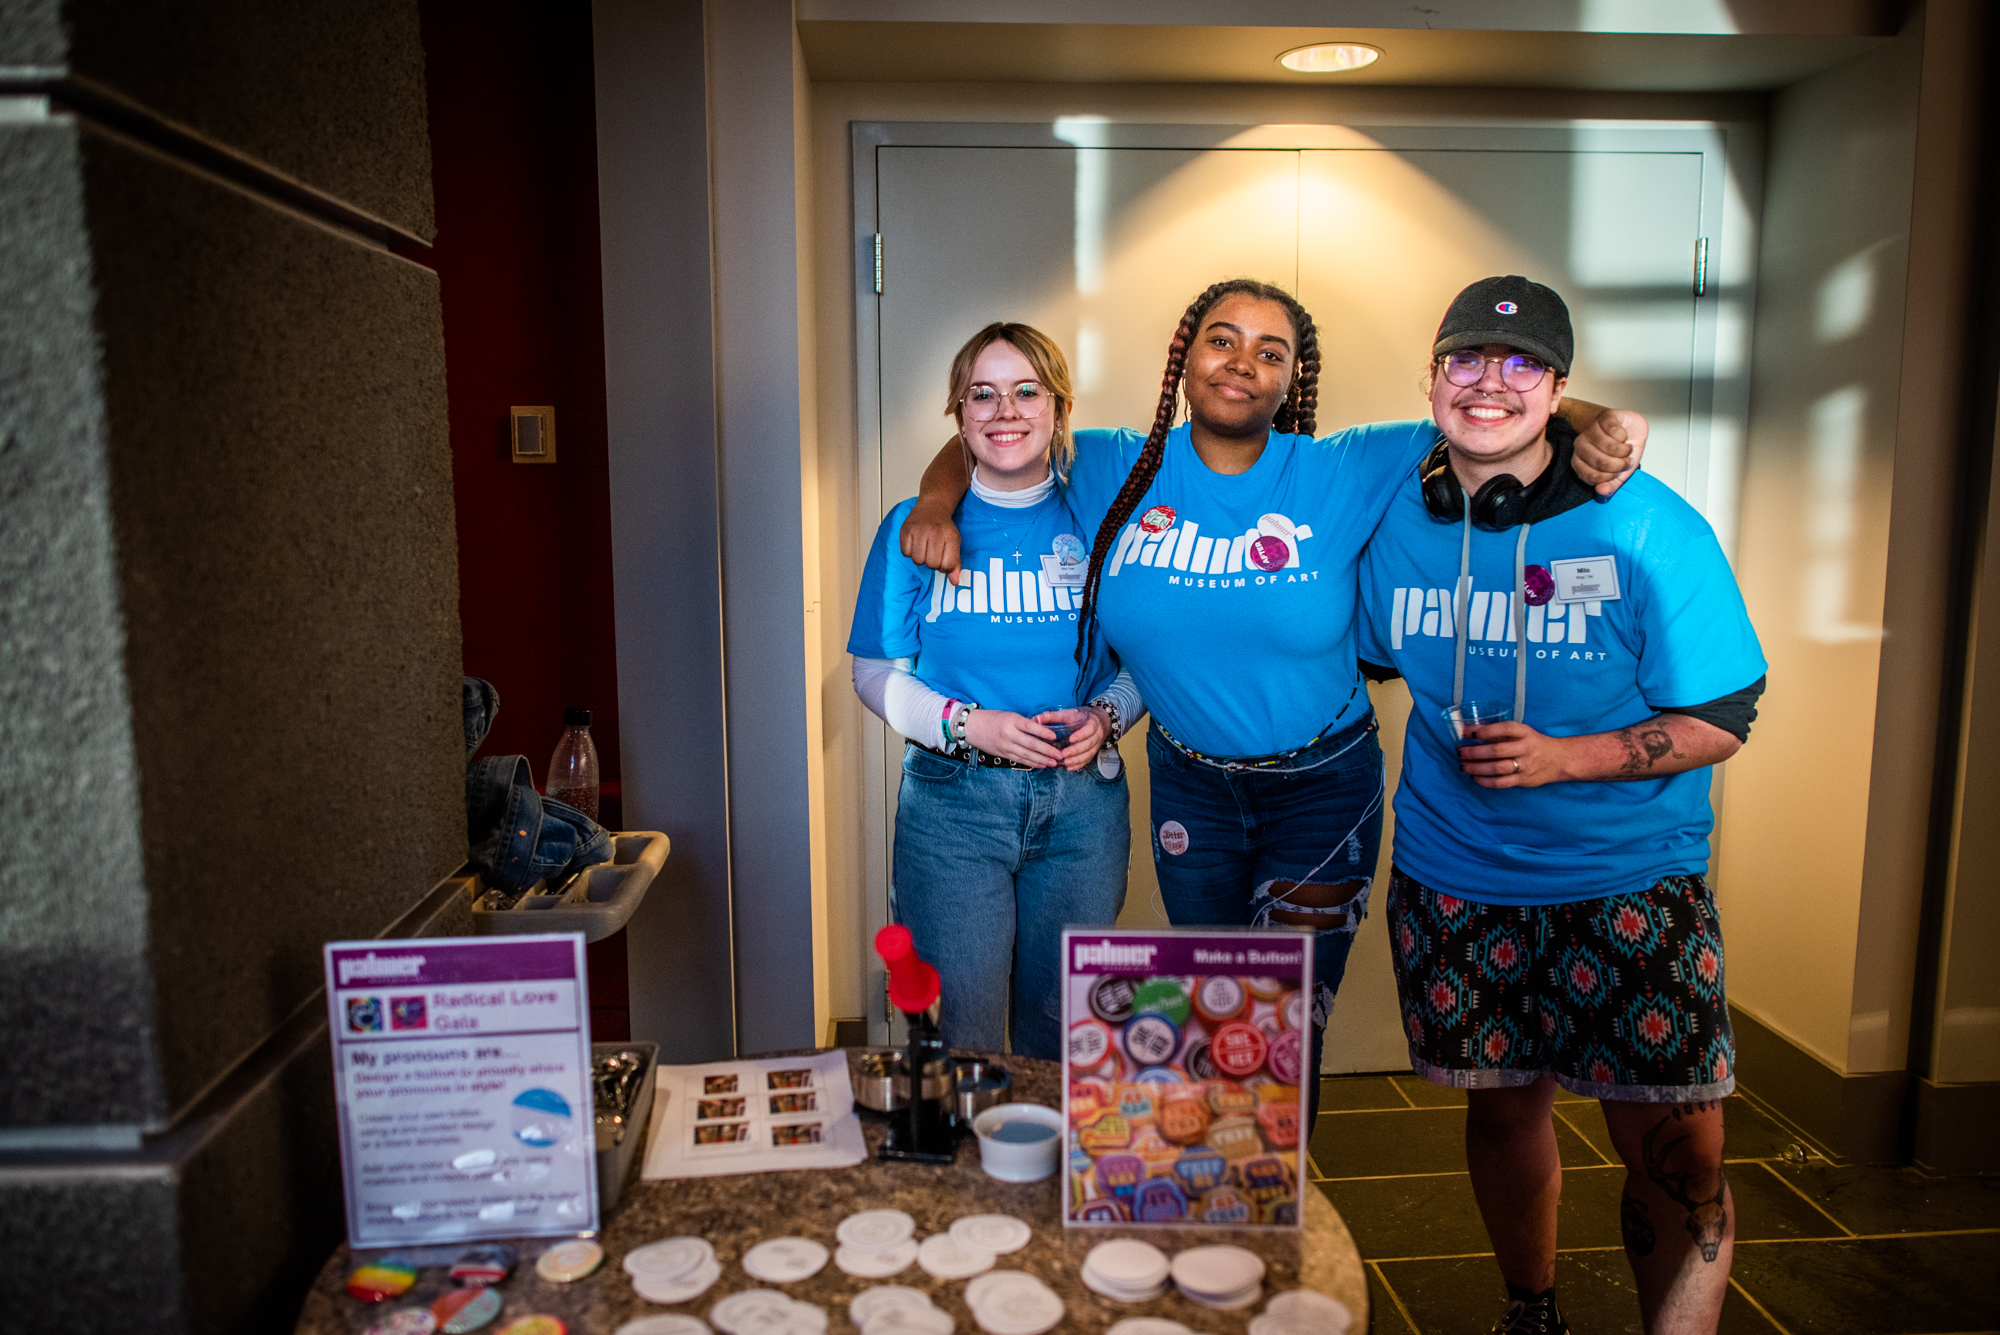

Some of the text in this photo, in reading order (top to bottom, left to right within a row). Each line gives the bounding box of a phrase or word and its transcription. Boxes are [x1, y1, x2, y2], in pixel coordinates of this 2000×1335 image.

[1109, 519, 1313, 576] palmr
[1254, 541, 1270, 563] AFTER
[1169, 571, 1318, 588] MUSEUM OF ART
[925, 557, 1098, 622] palme
[1571, 583, 1600, 595] palmer
[990, 612, 1077, 623] MUSEUM O
[1469, 645, 1606, 661] USEU OF ART
[1075, 939, 1157, 971] palmer
[1193, 949, 1233, 964] Make
[1235, 953, 1246, 964] a
[338, 952, 426, 984] palmer
[510, 989, 557, 1006] Love
[352, 1051, 376, 1067] My
[383, 1050, 469, 1067] pronouns
